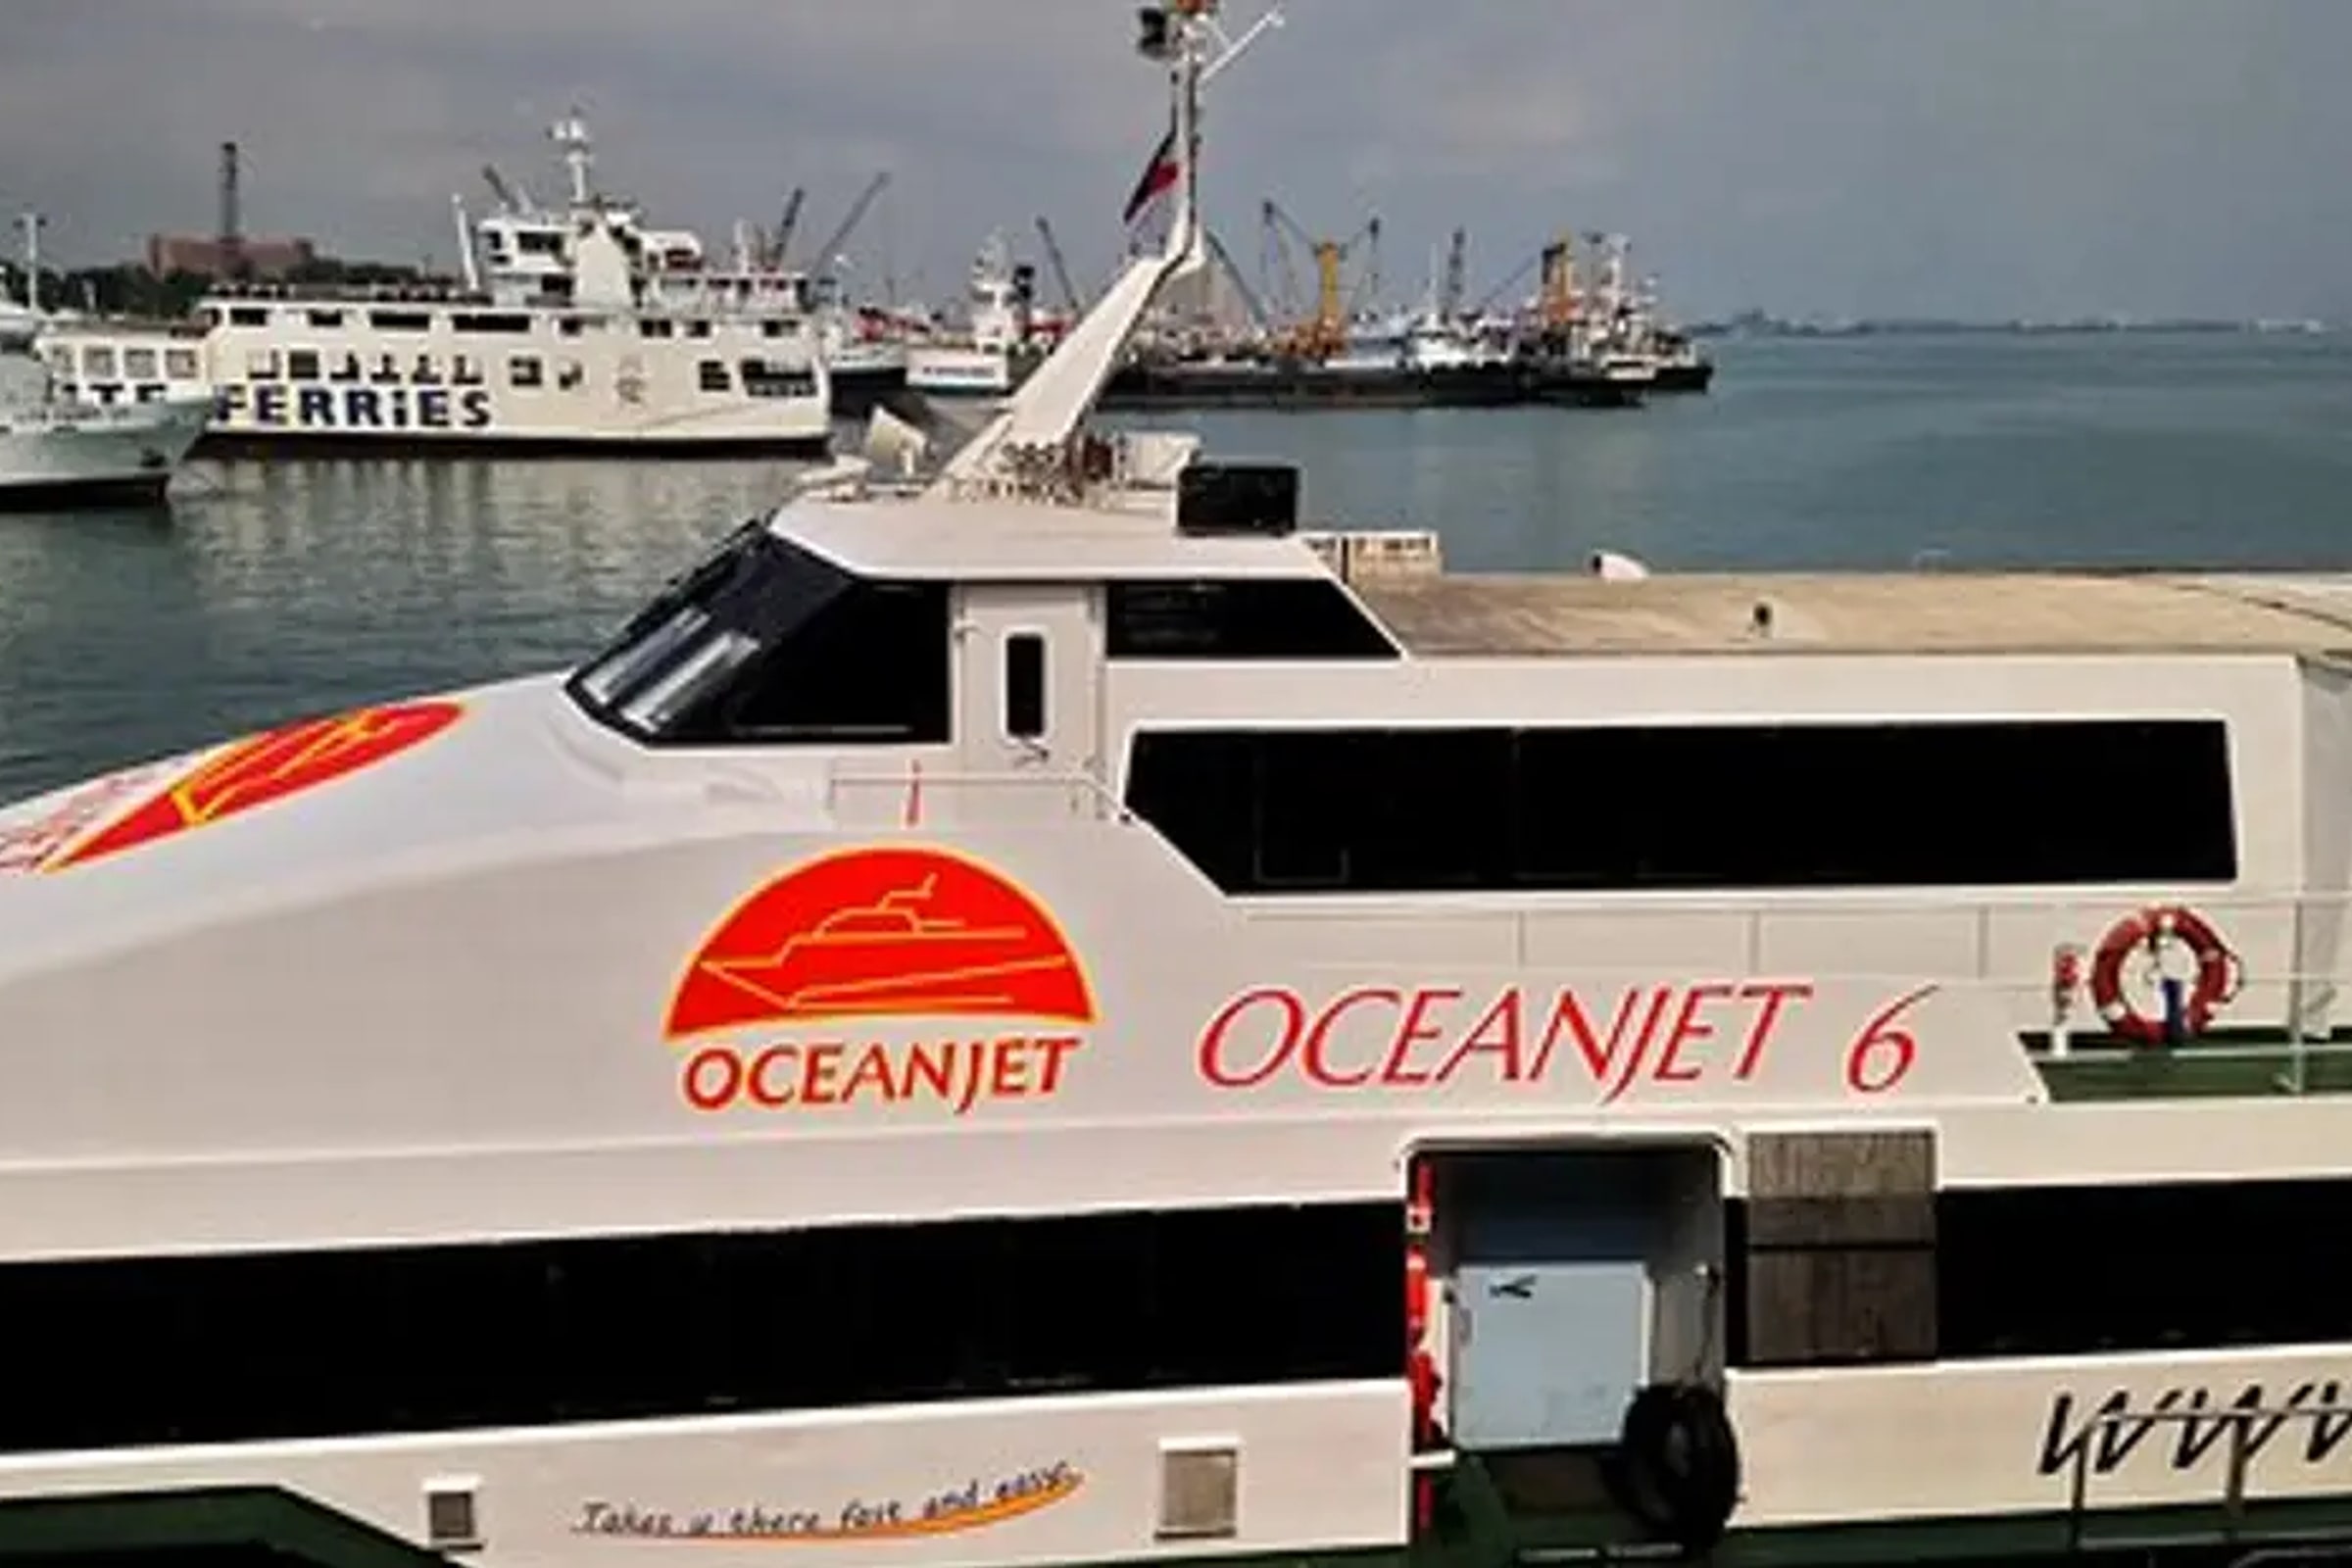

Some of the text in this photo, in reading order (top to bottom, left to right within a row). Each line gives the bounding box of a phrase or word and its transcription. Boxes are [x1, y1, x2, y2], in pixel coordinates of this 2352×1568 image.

[686, 1037, 1082, 1114] OCEANJET
[1198, 983, 1942, 1105] OCEANJET 6
